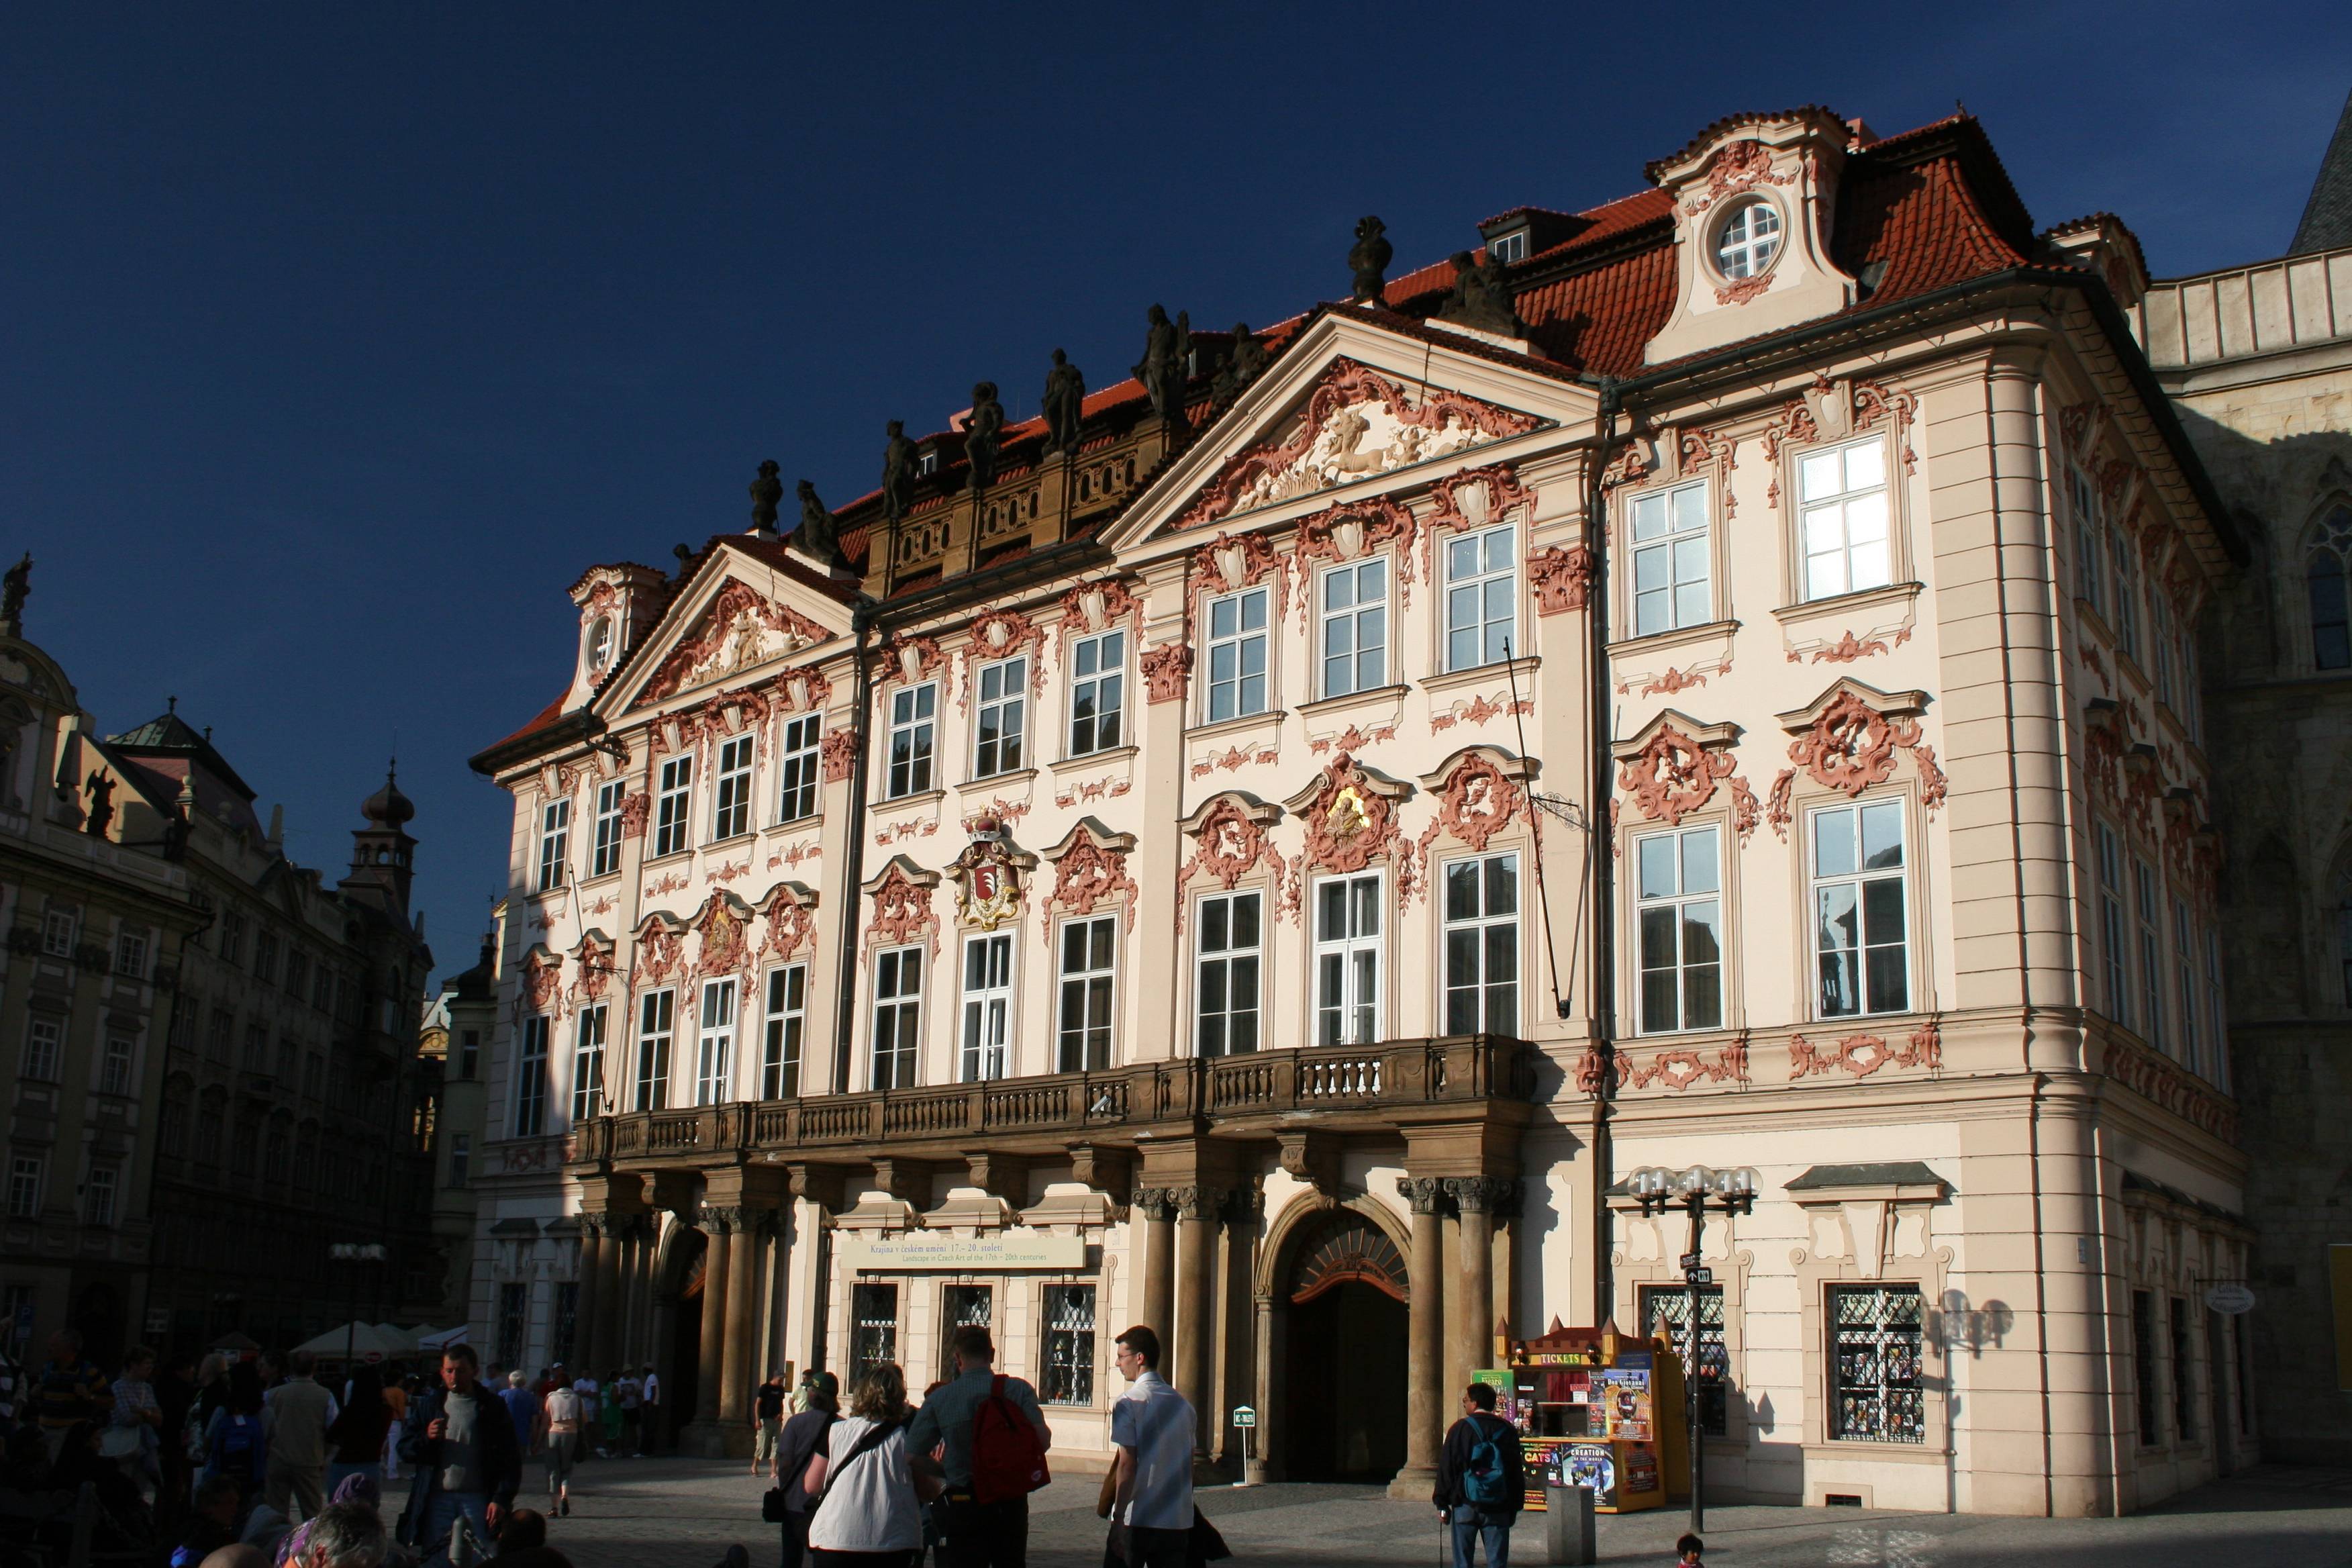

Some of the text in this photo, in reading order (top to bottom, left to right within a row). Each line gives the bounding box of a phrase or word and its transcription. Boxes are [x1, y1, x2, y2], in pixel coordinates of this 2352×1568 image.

[871, 1244, 893, 1255] Krajina
[901, 1244, 924, 1253] českém
[926, 1244, 946, 1252] umění
[968, 1243, 979, 1251] 20.
[981, 1242, 1003, 1251] století
[1540, 1354, 1580, 1364] TICKETS
[1524, 1453, 1551, 1463] CATS
